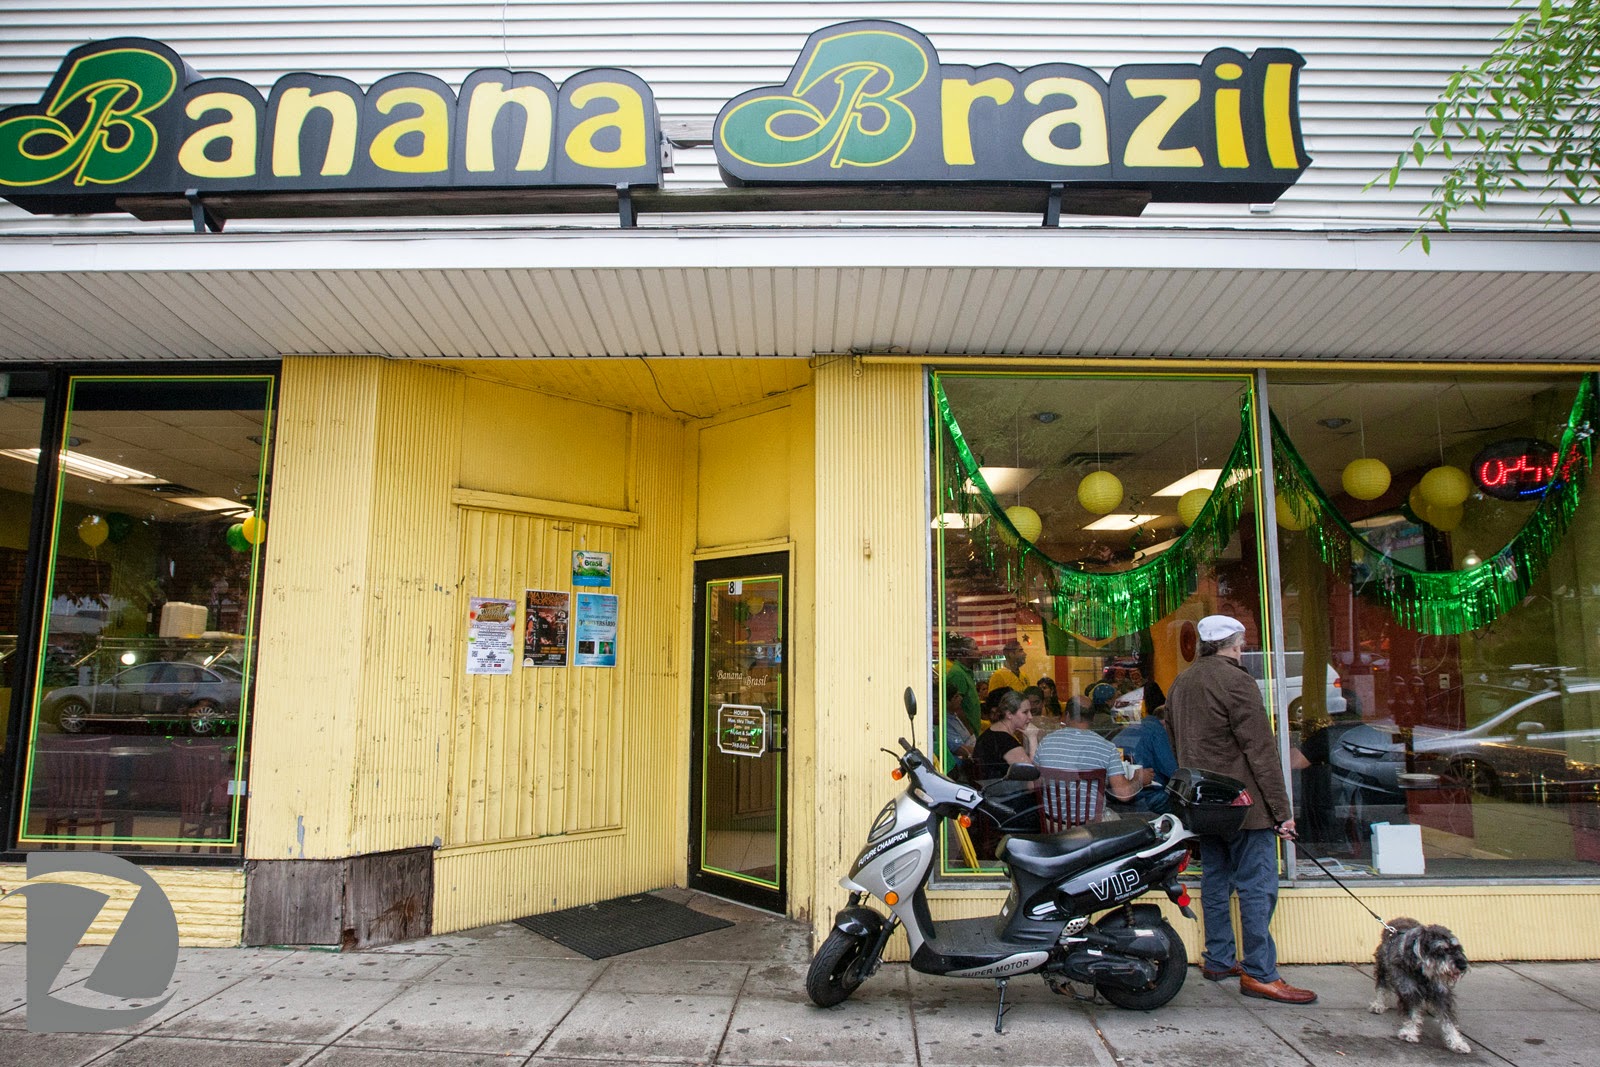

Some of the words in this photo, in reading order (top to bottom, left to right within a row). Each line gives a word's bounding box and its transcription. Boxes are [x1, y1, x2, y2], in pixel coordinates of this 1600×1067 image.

[0, 47, 647, 187] Banana
[719, 29, 1300, 170] Brazil
[584, 559, 603, 567] Brasil
[729, 581, 735, 594] 8
[716, 669, 743, 680] Banana
[744, 674, 768, 688] Brasil
[857, 846, 877, 868] FUTURE
[876, 830, 909, 852] CHAMPION
[1087, 868, 1140, 902] VIP
[961, 968, 993, 978] SUPER
[995, 959, 1029, 973] MOTOR
